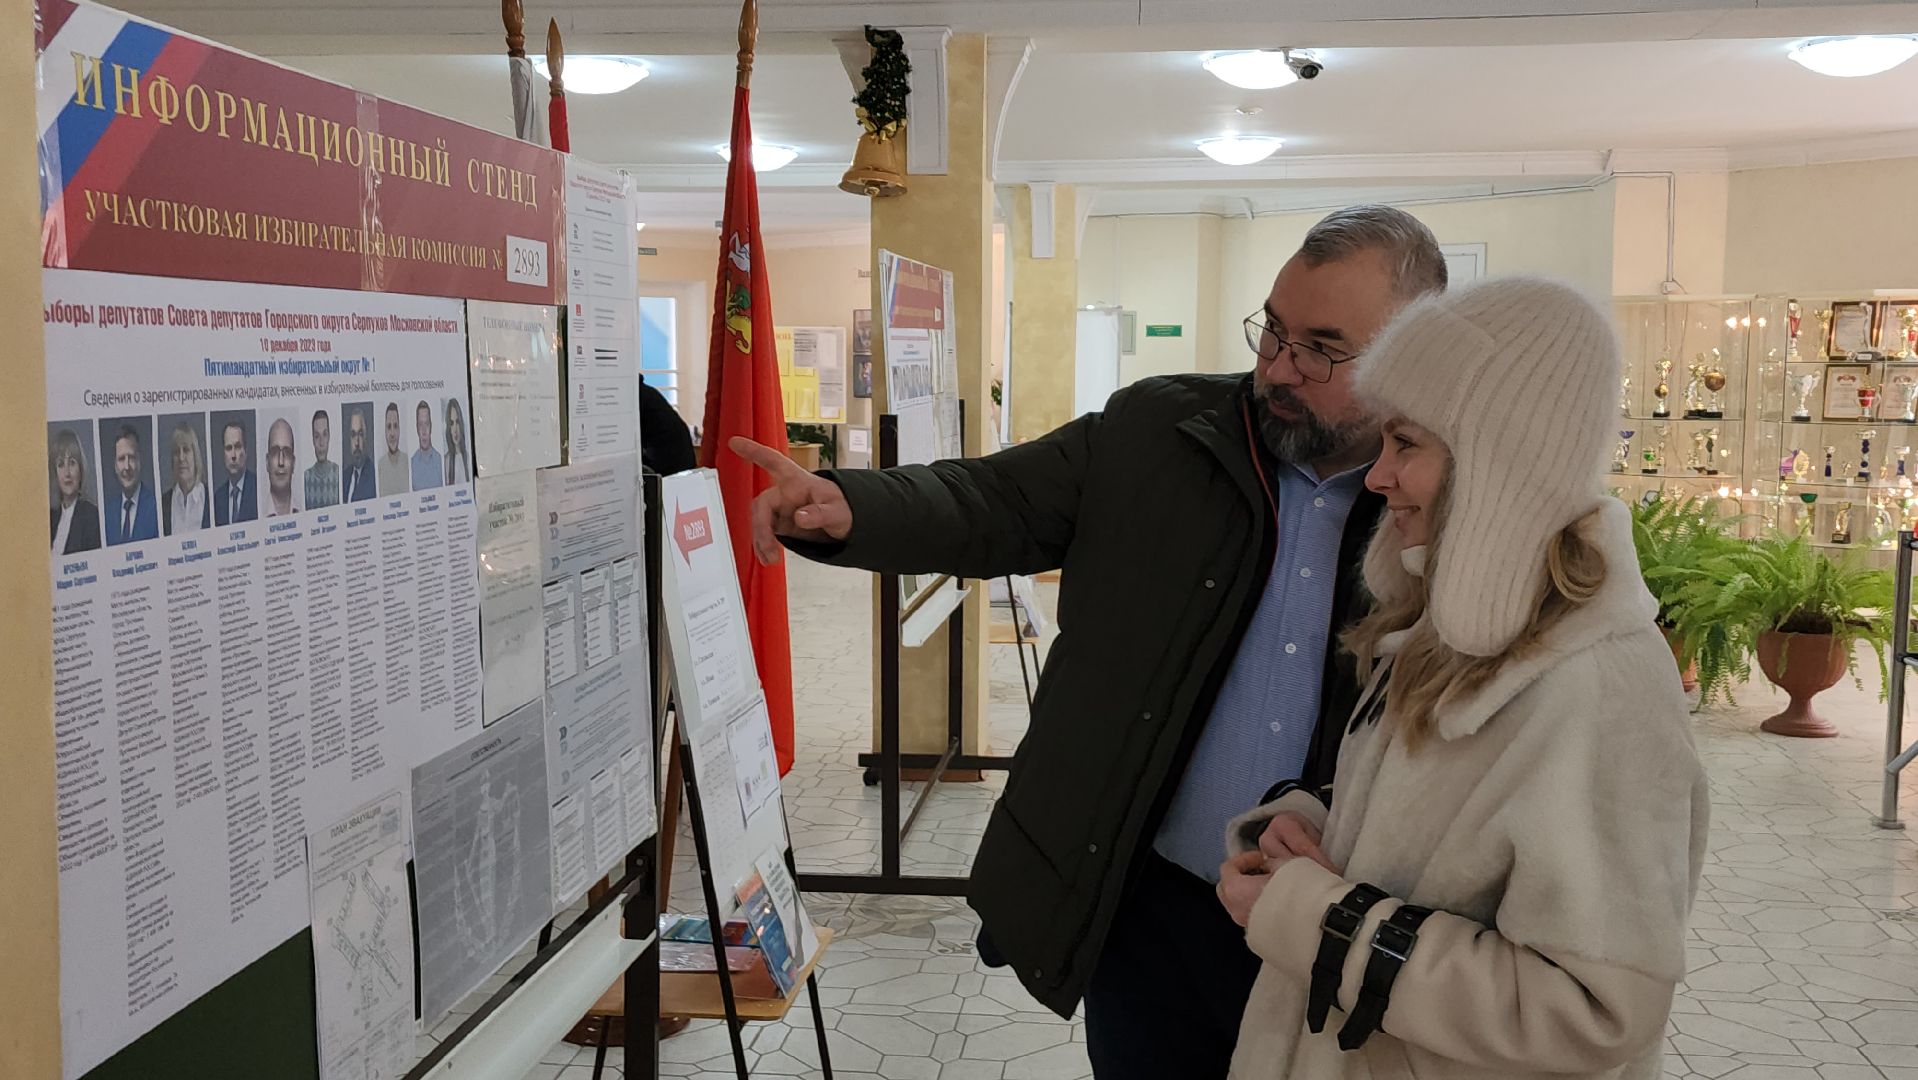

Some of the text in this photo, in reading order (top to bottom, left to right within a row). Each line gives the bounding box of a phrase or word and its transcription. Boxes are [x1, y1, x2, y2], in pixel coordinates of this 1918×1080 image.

[72, 51, 538, 213] ИНФОРМАЦИОННЫЙ СТЕНД
[84, 188, 504, 271] УЧАСТКОВАЯ ИЗБИРАТЕЛЬНАЯ КОМИССИЯ №
[514, 247, 541, 277] 2893
[44, 299, 458, 334] ыборы депутатов Совета депутатов Городского округа Серпухов Московской области
[260, 337, 331, 353] 10 декабря 2023 года
[204, 356, 277, 378] Пятимандатный
[279, 357, 339, 377] избирательный
[341, 359, 360, 376] округ
[84, 389, 132, 407] Сведения
[134, 391, 140, 402] о
[142, 387, 234, 406] зарегистрированных
[235, 385, 279, 401] кандидатах,
[281, 383, 318, 398] внесенных
[324, 380, 370, 396] избирательный
[371, 379, 400, 393] бюллетень
